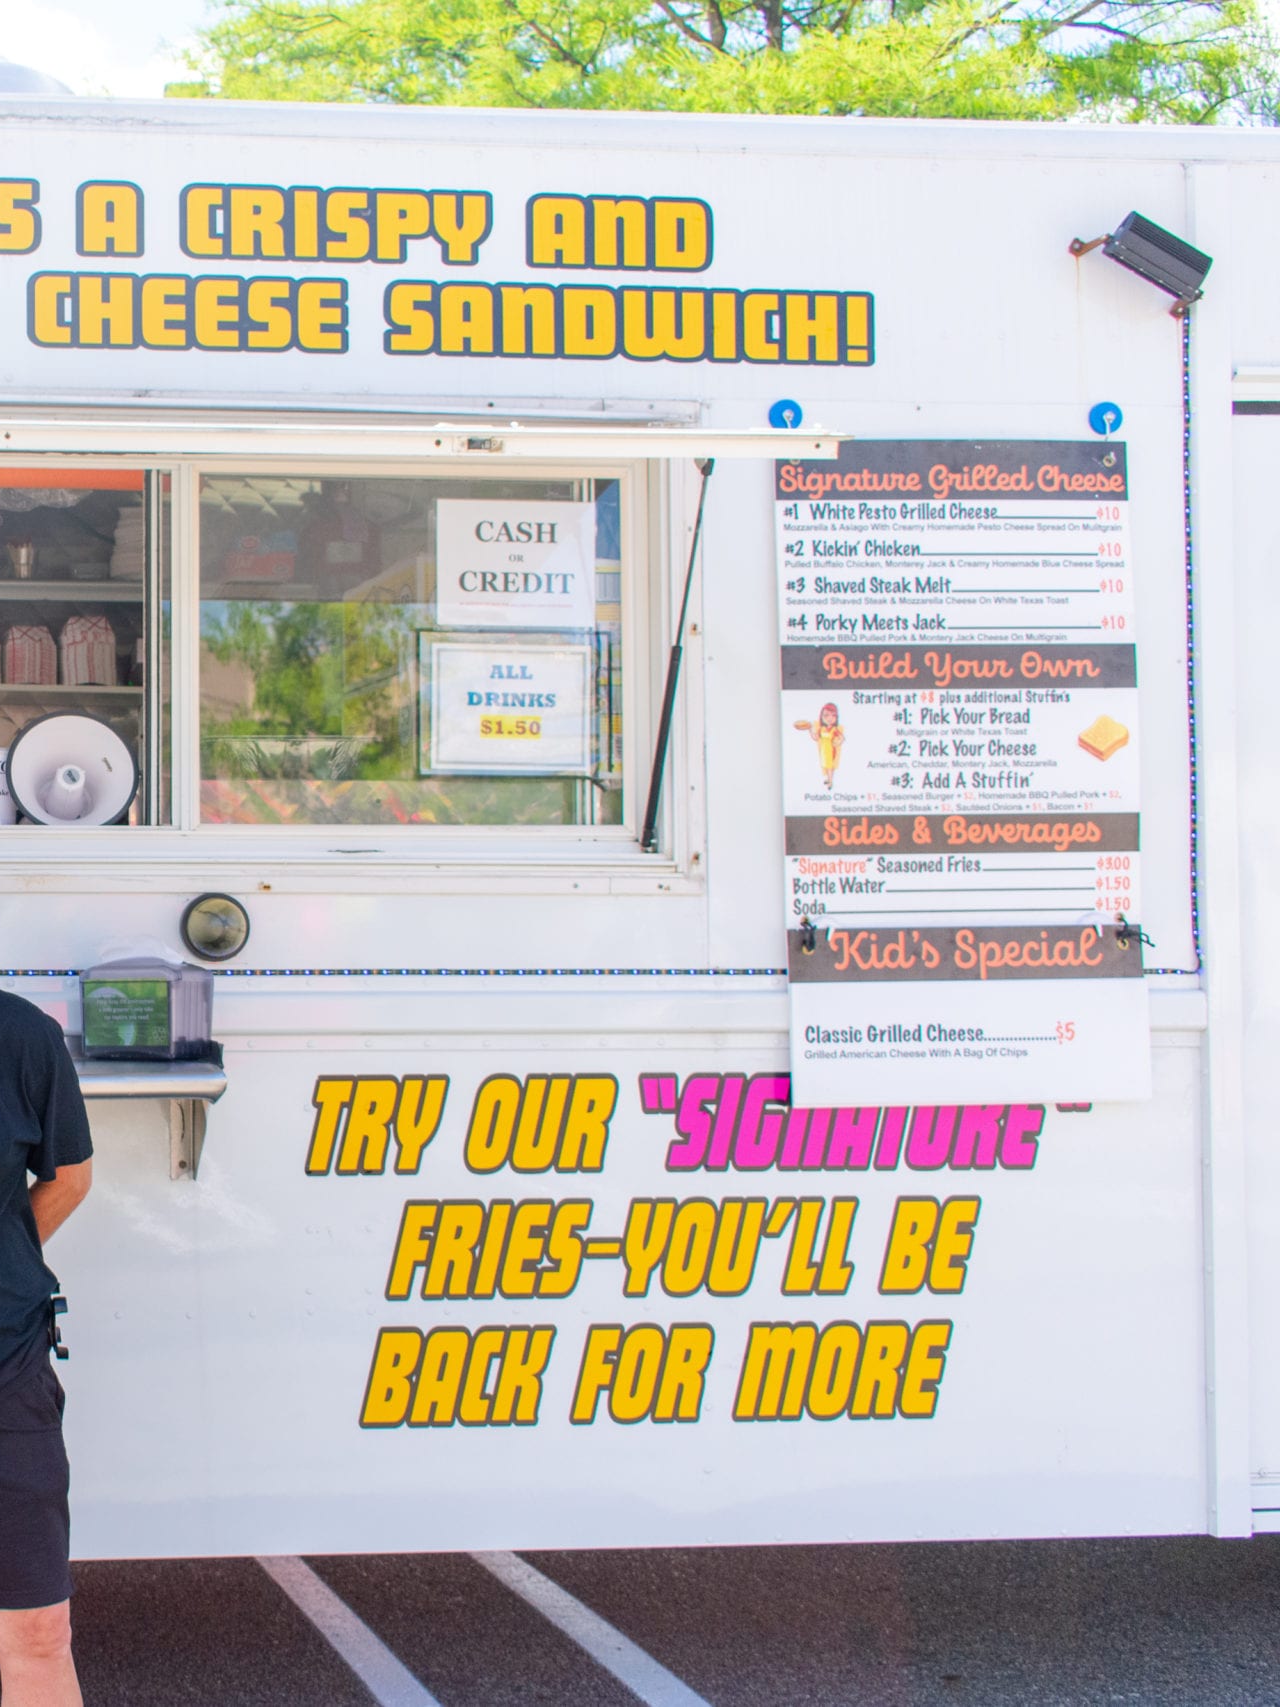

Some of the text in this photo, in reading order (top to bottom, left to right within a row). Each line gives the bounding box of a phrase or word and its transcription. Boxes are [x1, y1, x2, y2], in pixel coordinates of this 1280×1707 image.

[76, 180, 144, 258] A
[179, 182, 493, 266] CRISPY
[527, 192, 713, 272] AND
[27, 271, 349, 355] CHEESE
[384, 279, 875, 366] SANDWICH!
[780, 464, 1125, 499] Signature Grilled Cheese
[784, 506, 799, 520] #1
[810, 503, 857, 520] White
[859, 503, 896, 520] Pesto
[900, 503, 947, 520] Grilled
[949, 503, 997, 519] Cheese
[476, 521, 558, 543] CASH
[784, 523, 1066, 532] Mozzarella Asiago With Creamy Homemade Pesto Cheese Spread
[785, 543, 803, 556] #2
[812, 540, 860, 556] Kickin'
[865, 539, 920, 557] Chicken
[784, 560, 811, 568] Pulled
[813, 560, 844, 568] Buffalo
[927, 560, 946, 568] Jack
[957, 560, 990, 569] Creamy
[992, 560, 1039, 568] Homemade
[1042, 560, 1060, 568] Blue
[1062, 560, 1093, 568] Cheese
[1095, 560, 1124, 569] Spread
[459, 571, 574, 594] CREDIT
[786, 579, 805, 593] #3
[814, 577, 865, 594] Shaved
[870, 576, 912, 593] Steak
[915, 576, 951, 593] Melt
[787, 617, 807, 630] #4
[816, 614, 857, 633] Porky
[863, 613, 908, 630] Meets
[912, 612, 946, 630] Jack
[838, 634, 857, 642] BBQ
[490, 665, 533, 680] ALL
[823, 652, 1100, 686] Build Your Own
[467, 692, 556, 708] DRINKS
[853, 692, 901, 706] Starting
[904, 692, 917, 704] at
[940, 691, 961, 705] plus
[964, 691, 1022, 704] additional
[893, 707, 1030, 724] #1: Pick Your Bread
[480, 720, 540, 736] $1.50
[950, 728, 975, 736] White
[978, 728, 1002, 736] Texas
[1005, 728, 1028, 736] Toast
[888, 739, 1036, 756] #2: Pick Your Cheese
[891, 772, 1033, 789] #3: Add A Stuffin'
[823, 816, 1101, 851] Sides & Beverages
[877, 857, 943, 874] Seasoned
[947, 857, 981, 873] Fries
[793, 878, 836, 894] Bottle
[840, 878, 885, 893] Water
[793, 899, 826, 915] Soda
[829, 928, 1103, 980] Kid's Special
[805, 1026, 862, 1043] Classic
[867, 1025, 921, 1043] Grilled
[1056, 1021, 1075, 1044] $5
[805, 1048, 1028, 1059] Grilled American Cheese With A Bag Of Chips
[305, 1072, 1092, 1176] TRY OUR "SIGNATURE
[878, 1195, 981, 1296] BE
[359, 1319, 953, 1428] BACK FOR MORE
